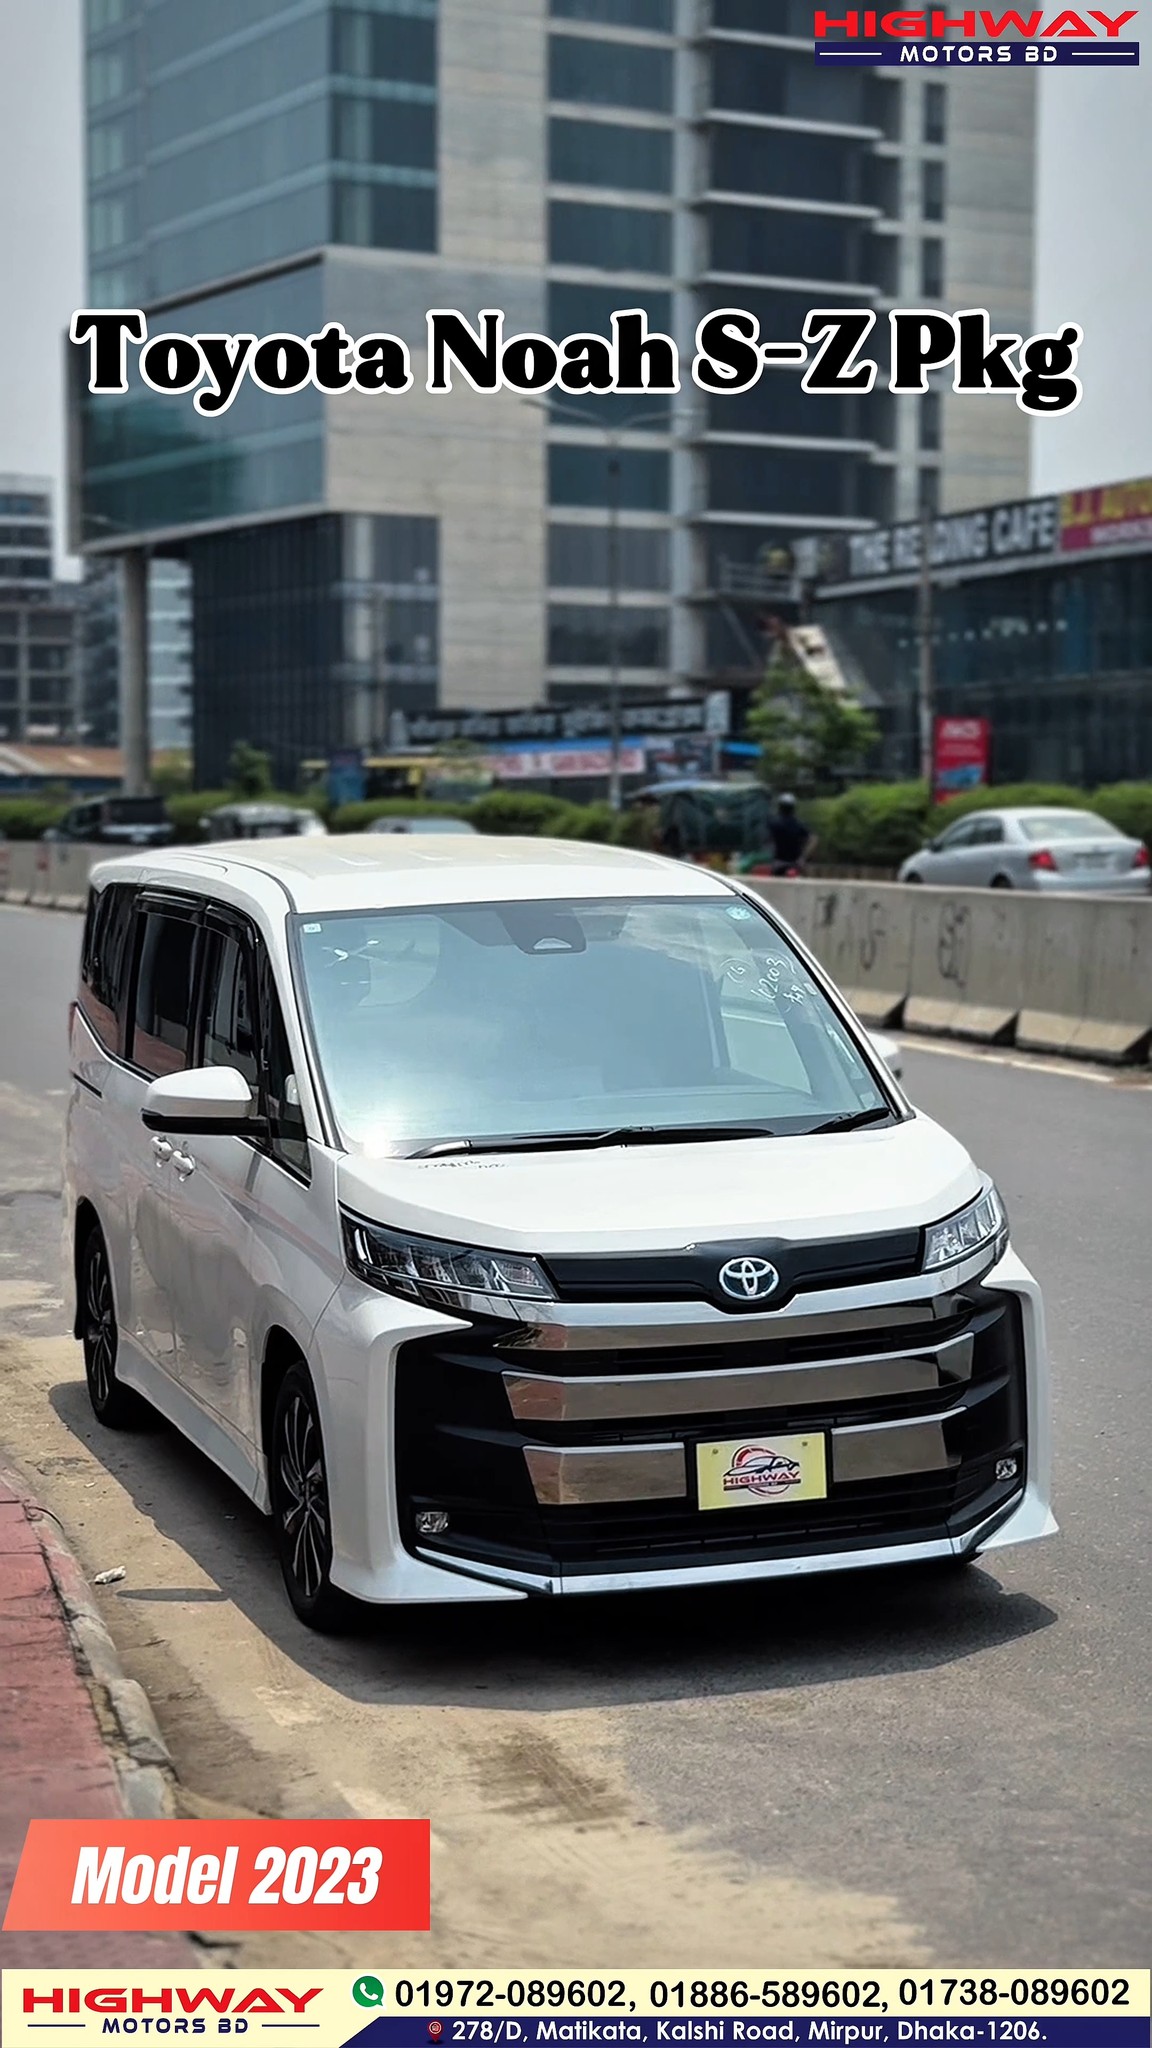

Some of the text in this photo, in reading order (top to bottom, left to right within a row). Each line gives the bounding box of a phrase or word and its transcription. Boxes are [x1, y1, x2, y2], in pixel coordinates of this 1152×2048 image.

[893, 511, 990, 571] REDING
[992, 500, 1056, 553] CAFE
[723, 1471, 800, 1486] HIGHWAY
